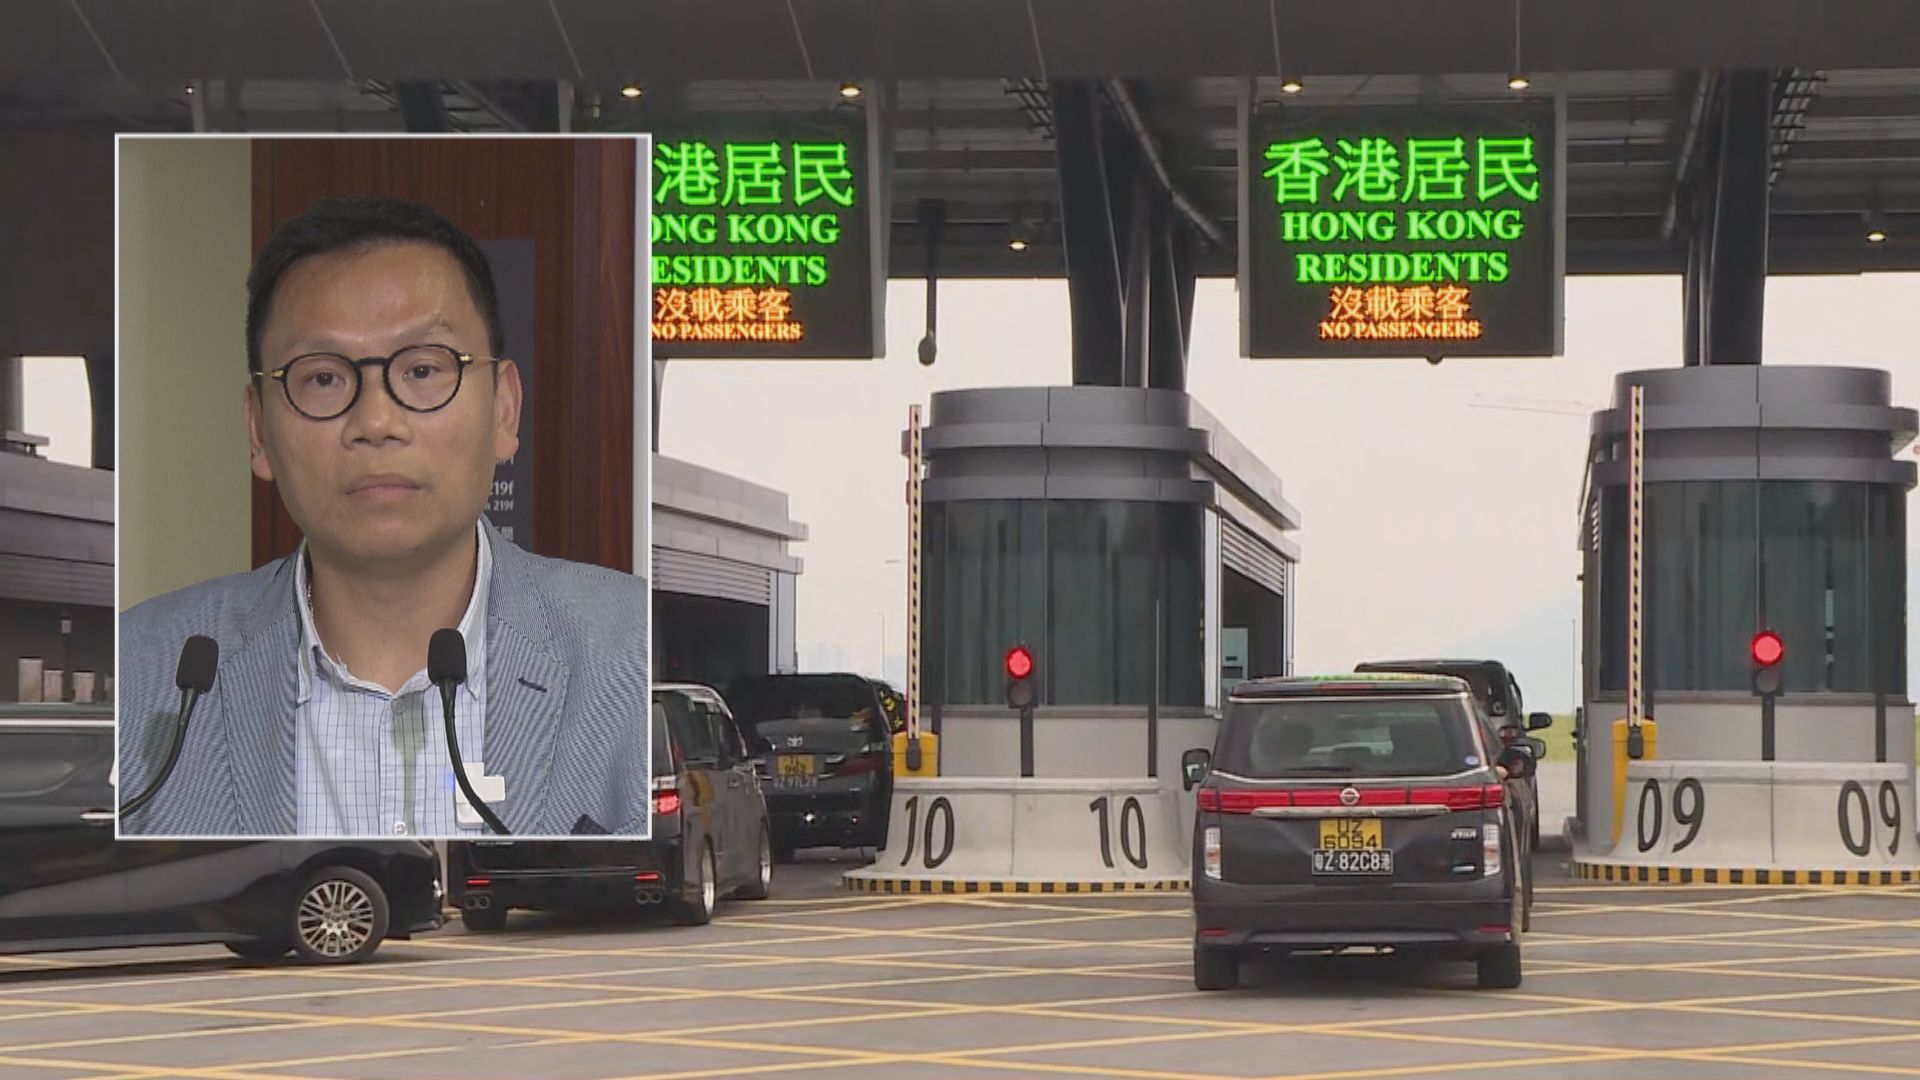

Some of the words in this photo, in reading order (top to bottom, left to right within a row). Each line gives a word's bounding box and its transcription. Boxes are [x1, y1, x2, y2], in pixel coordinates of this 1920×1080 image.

[654, 142, 854, 207] 港居民
[1263, 137, 1539, 203] 香港居民
[726, 214, 840, 243] KONG
[1281, 212, 1397, 241] HONG
[1406, 210, 1523, 239] KONG
[1296, 253, 1509, 282] RESIDENTS
[681, 323, 803, 339] PASSENGERS
[1320, 321, 1350, 338] NO
[1354, 321, 1481, 338] PASSENGERS
[900, 796, 955, 869] 10
[1089, 796, 1147, 869] 10
[1638, 778, 1704, 853] 09
[1838, 780, 1900, 856] 09
[1324, 834, 1377, 849] 6094
